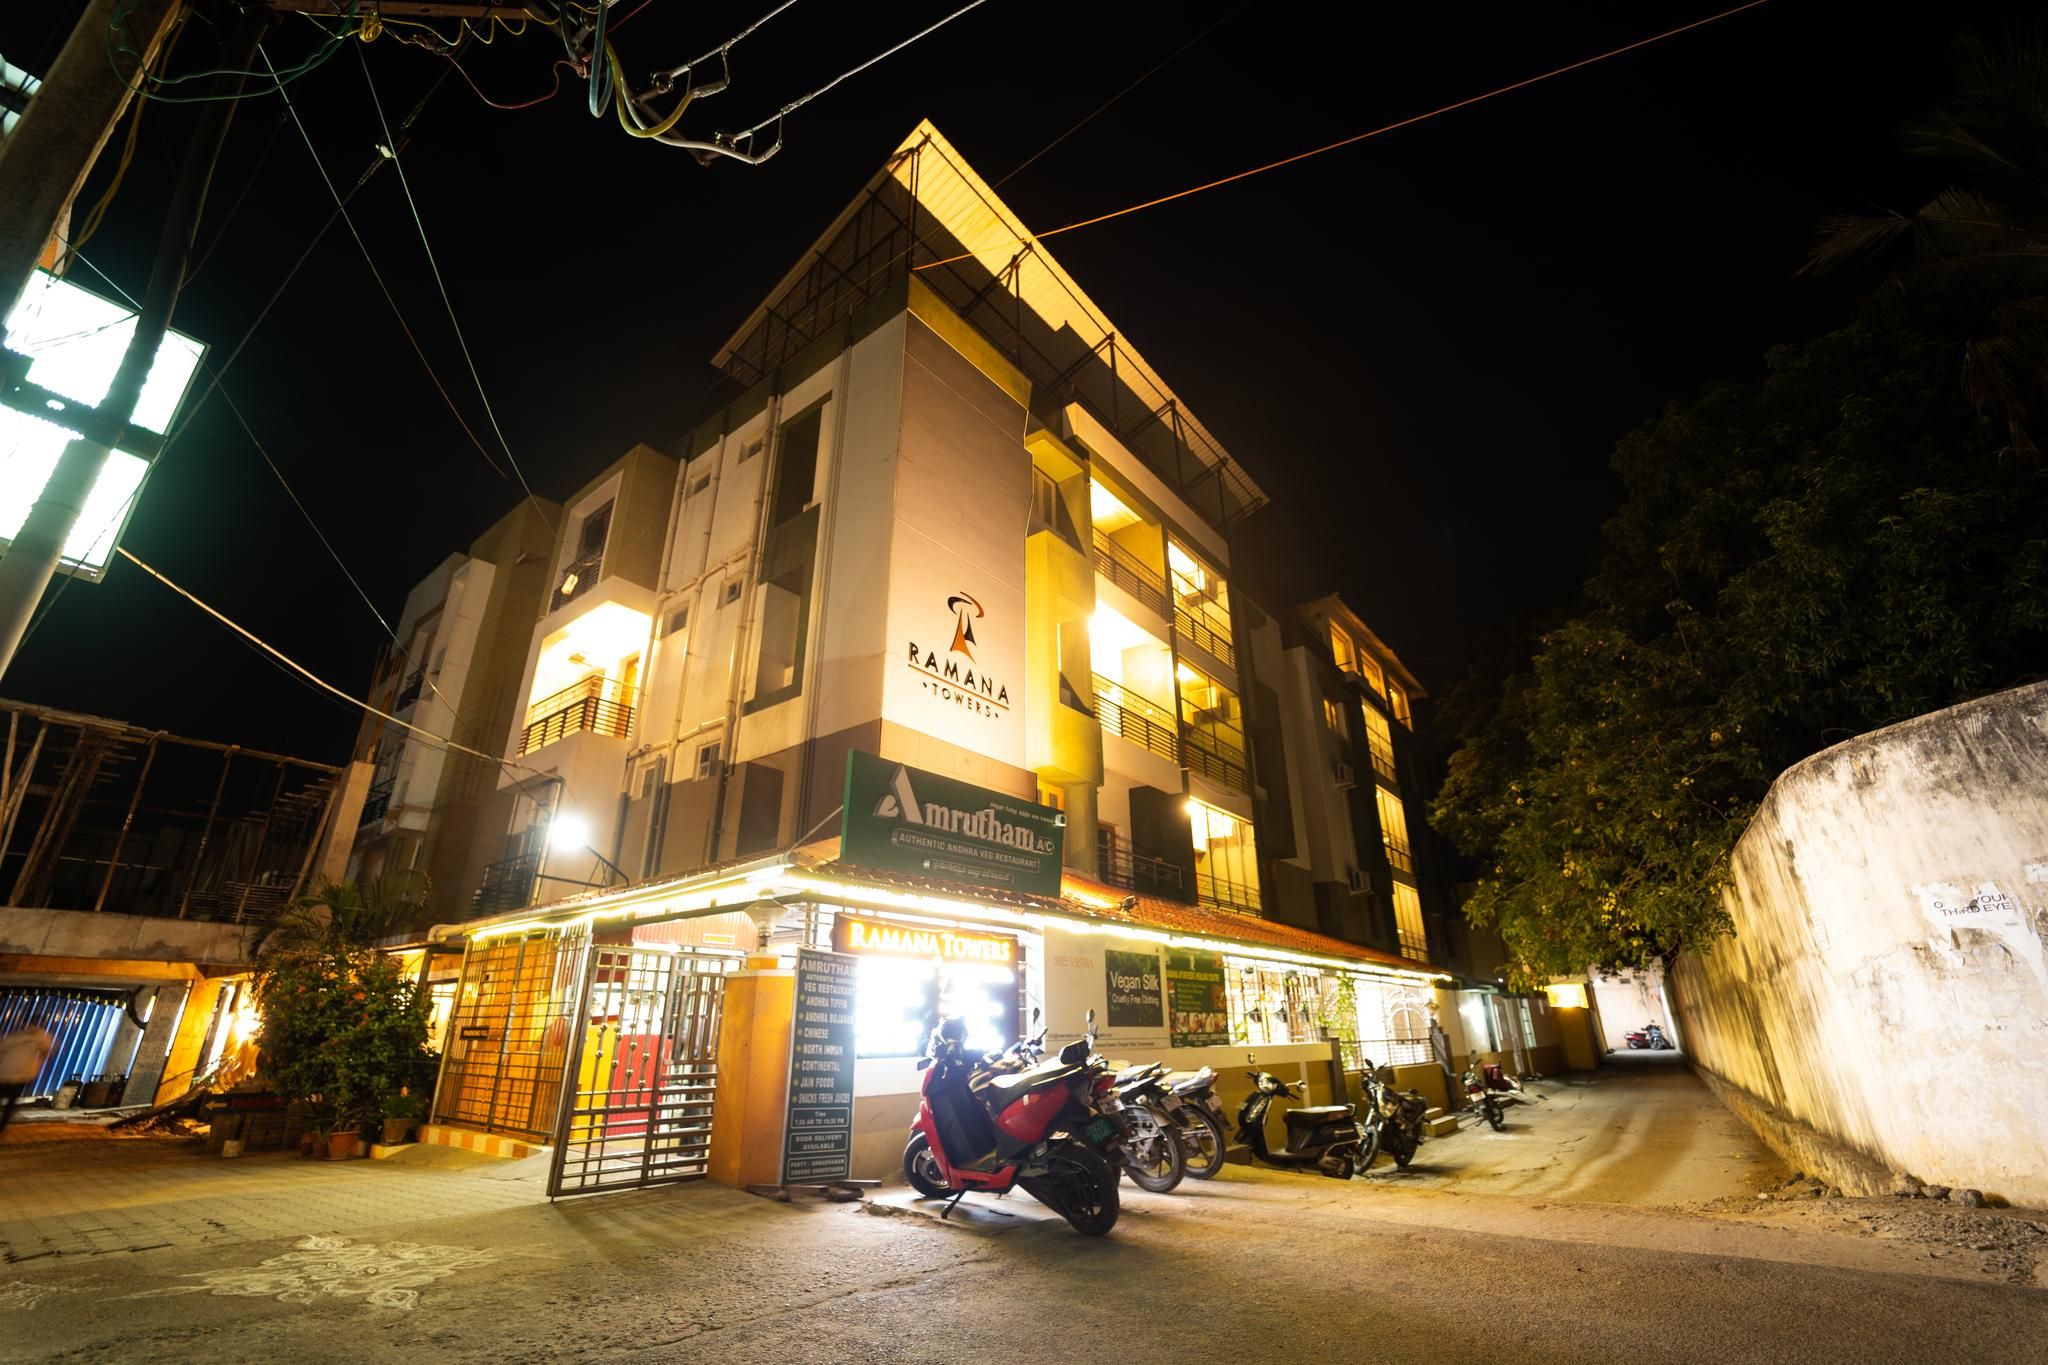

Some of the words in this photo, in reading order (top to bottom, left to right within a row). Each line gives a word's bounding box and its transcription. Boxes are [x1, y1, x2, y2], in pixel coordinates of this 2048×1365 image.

[909, 642, 1009, 704] RAMANA
[932, 683, 991, 717] TOWERS
[873, 765, 1034, 851] Amrutham
[1036, 839, 1053, 852] A/C
[899, 833, 945, 850] AUTHENTIC
[947, 842, 978, 857] ANDHRA
[980, 850, 994, 859] VEG
[995, 852, 1037, 869] RESTAURANT
[1983, 902, 2012, 912] EYE
[850, 922, 941, 955] RAMANA
[942, 933, 1010, 961] TOWERS
[804, 981, 817, 993] VEG
[1110, 970, 1141, 993] Vegan
[1143, 973, 1160, 990] Silk
[806, 995, 829, 1007] ANDHRA
[830, 997, 848, 1009] TIFFIN
[805, 1011, 828, 1023] ANDHRA
[804, 1027, 829, 1039] CHINESE
[803, 1043, 823, 1055] NORTH
[801, 1060, 840, 1072] CONTINENTAL
[800, 1077, 814, 1088] JAIN
[815, 1077, 834, 1088] FOODS
[803, 1142, 835, 1150] AVAILABLE
